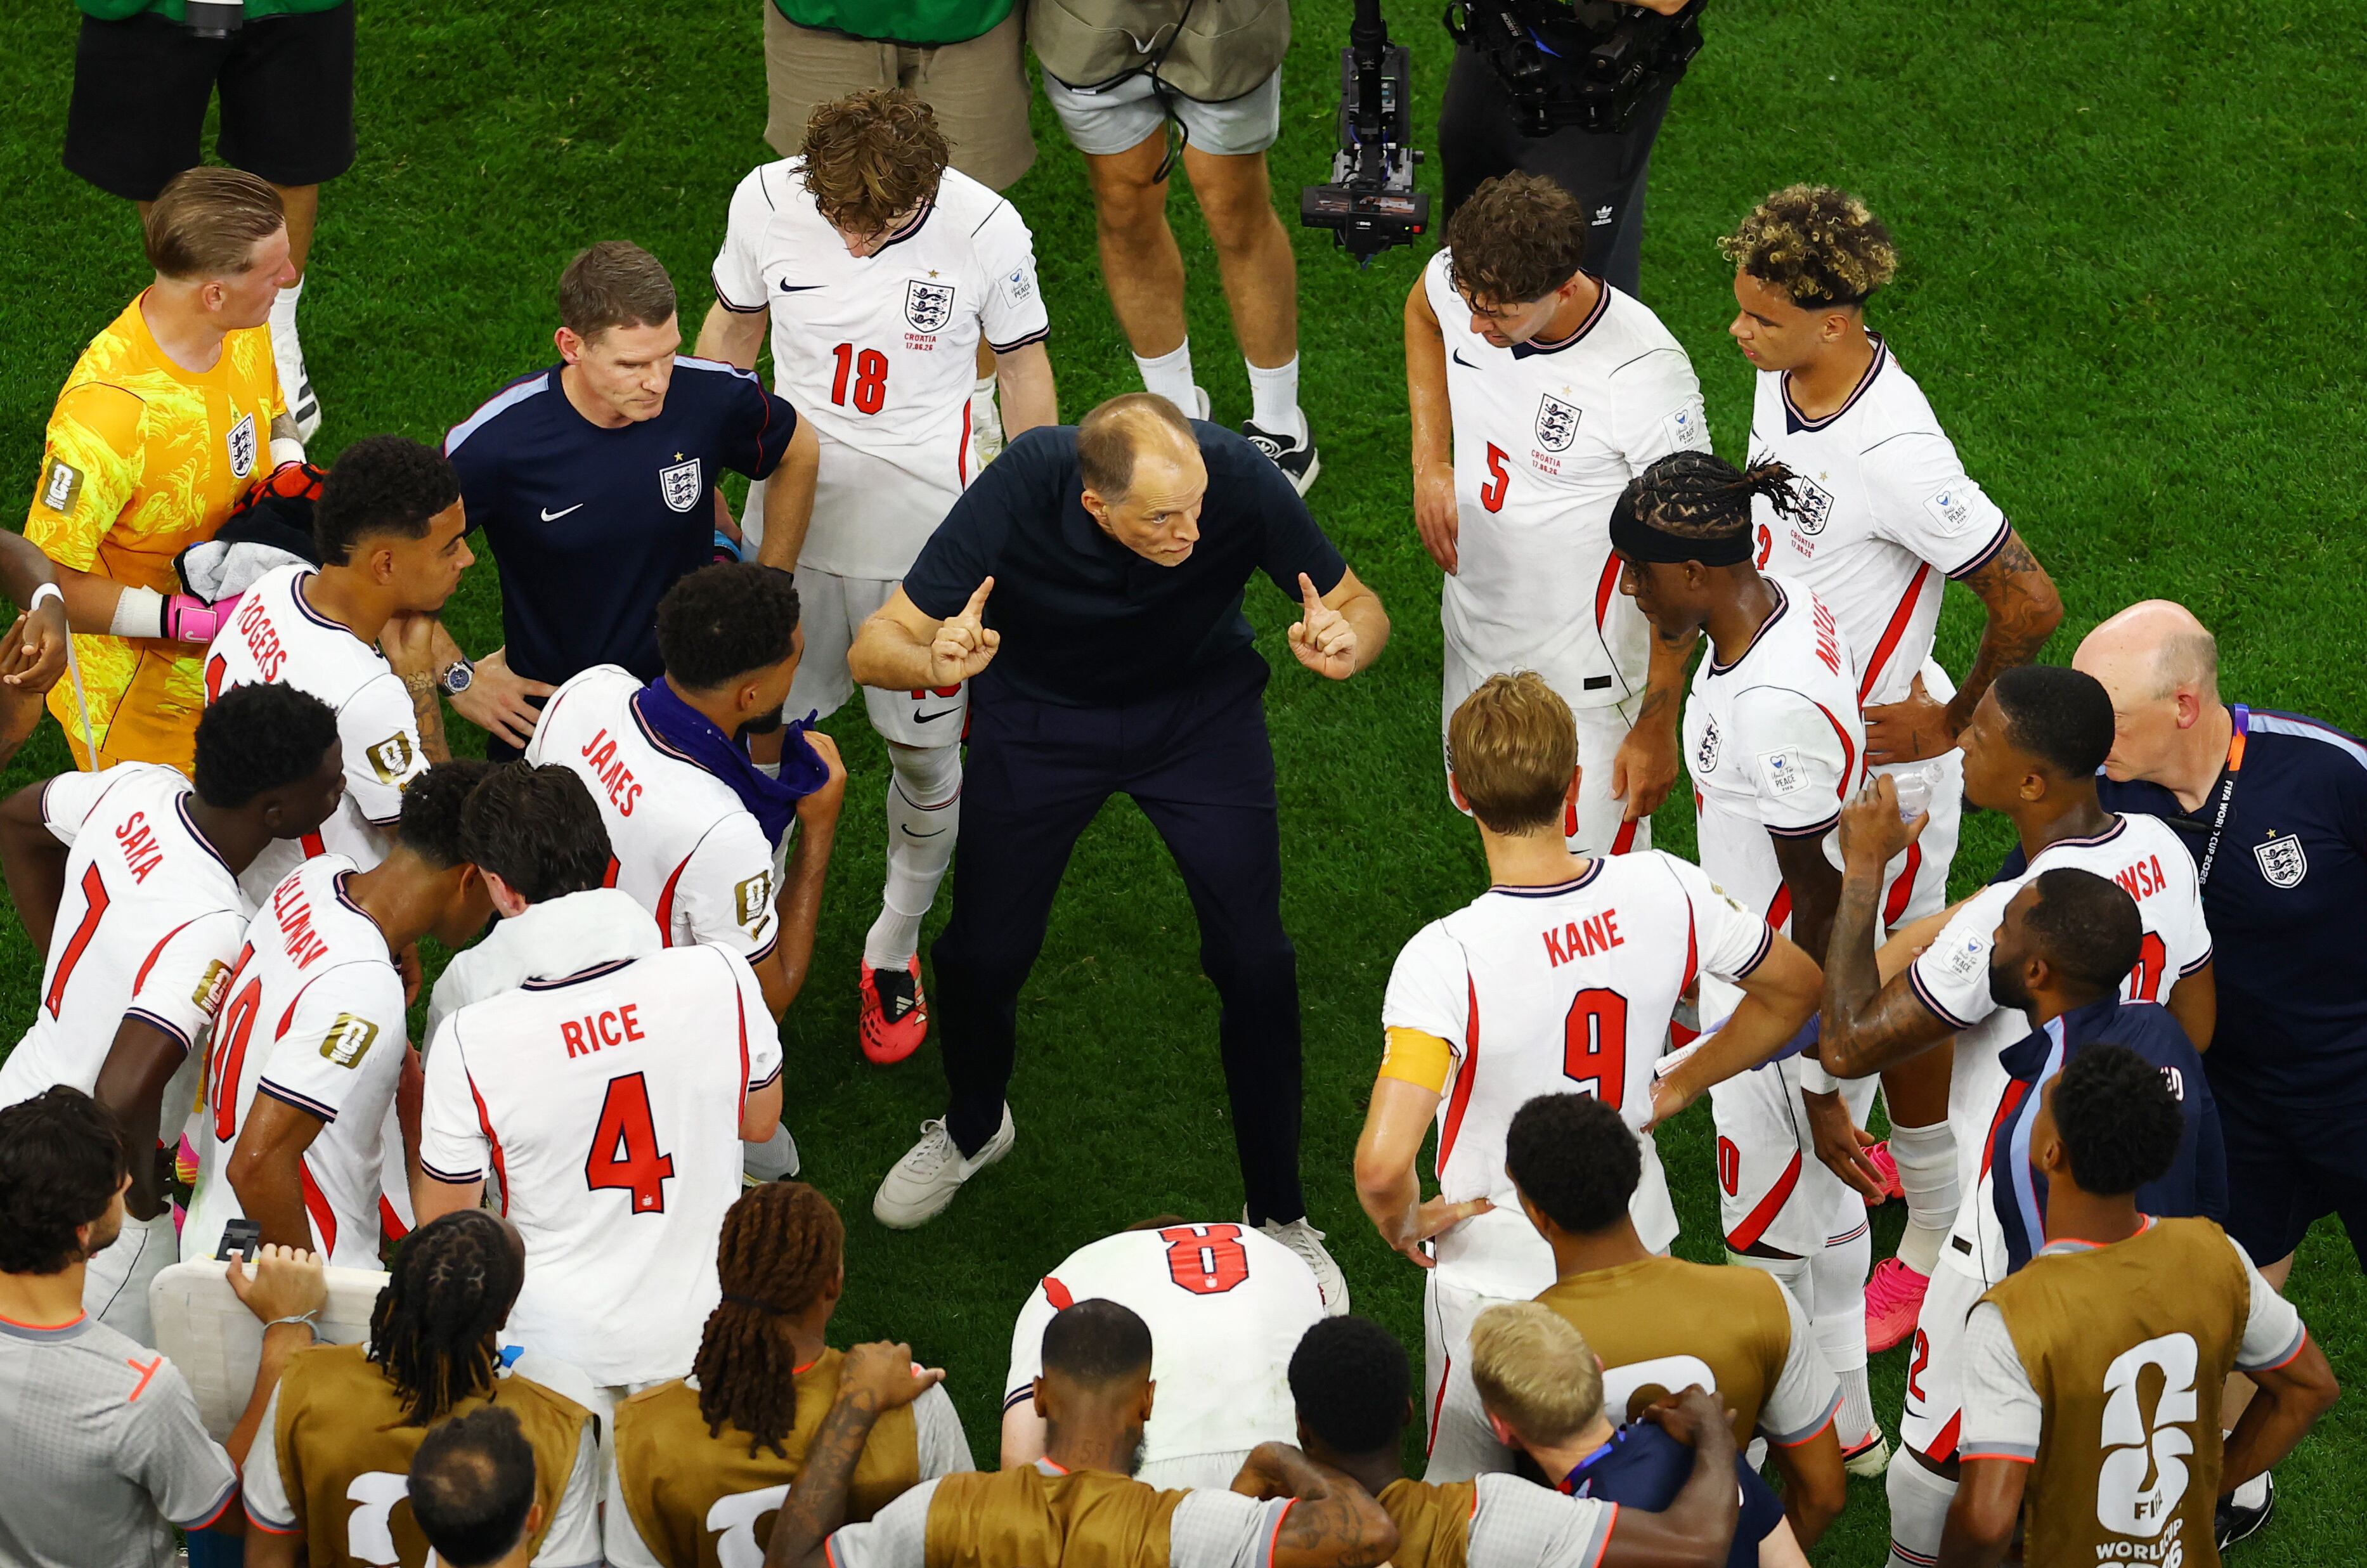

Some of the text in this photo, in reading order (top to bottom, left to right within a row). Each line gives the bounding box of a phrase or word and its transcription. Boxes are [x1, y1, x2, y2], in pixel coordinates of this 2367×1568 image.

[1015, 283, 1030, 299] PEACE
[904, 333, 937, 342] CROATIA
[906, 342, 933, 351] 17.06.26
[831, 343, 888, 415] 18
[1679, 425, 1694, 442] PEACE
[1531, 450, 1560, 468] CROATIA
[1480, 441, 1510, 514] 5
[1948, 504, 1967, 523] PEACE
[1791, 529, 1815, 551] CROATIA
[237, 593, 287, 683] ROGERS
[581, 729, 643, 818] JAMES
[1775, 774, 1796, 787] PEACE
[2222, 780, 2233, 801] FIFA
[116, 812, 164, 885] SAKA
[2209, 836, 2218, 855] CUP
[2199, 854, 2213, 885] 2026
[1542, 909, 1625, 968] KANE
[1952, 954, 1972, 973] PEACE
[561, 1003, 645, 1059] RICE
[1563, 987, 1628, 1111] 9
[585, 1071, 675, 1215] 4
[1909, 1327, 1929, 1403] 2
